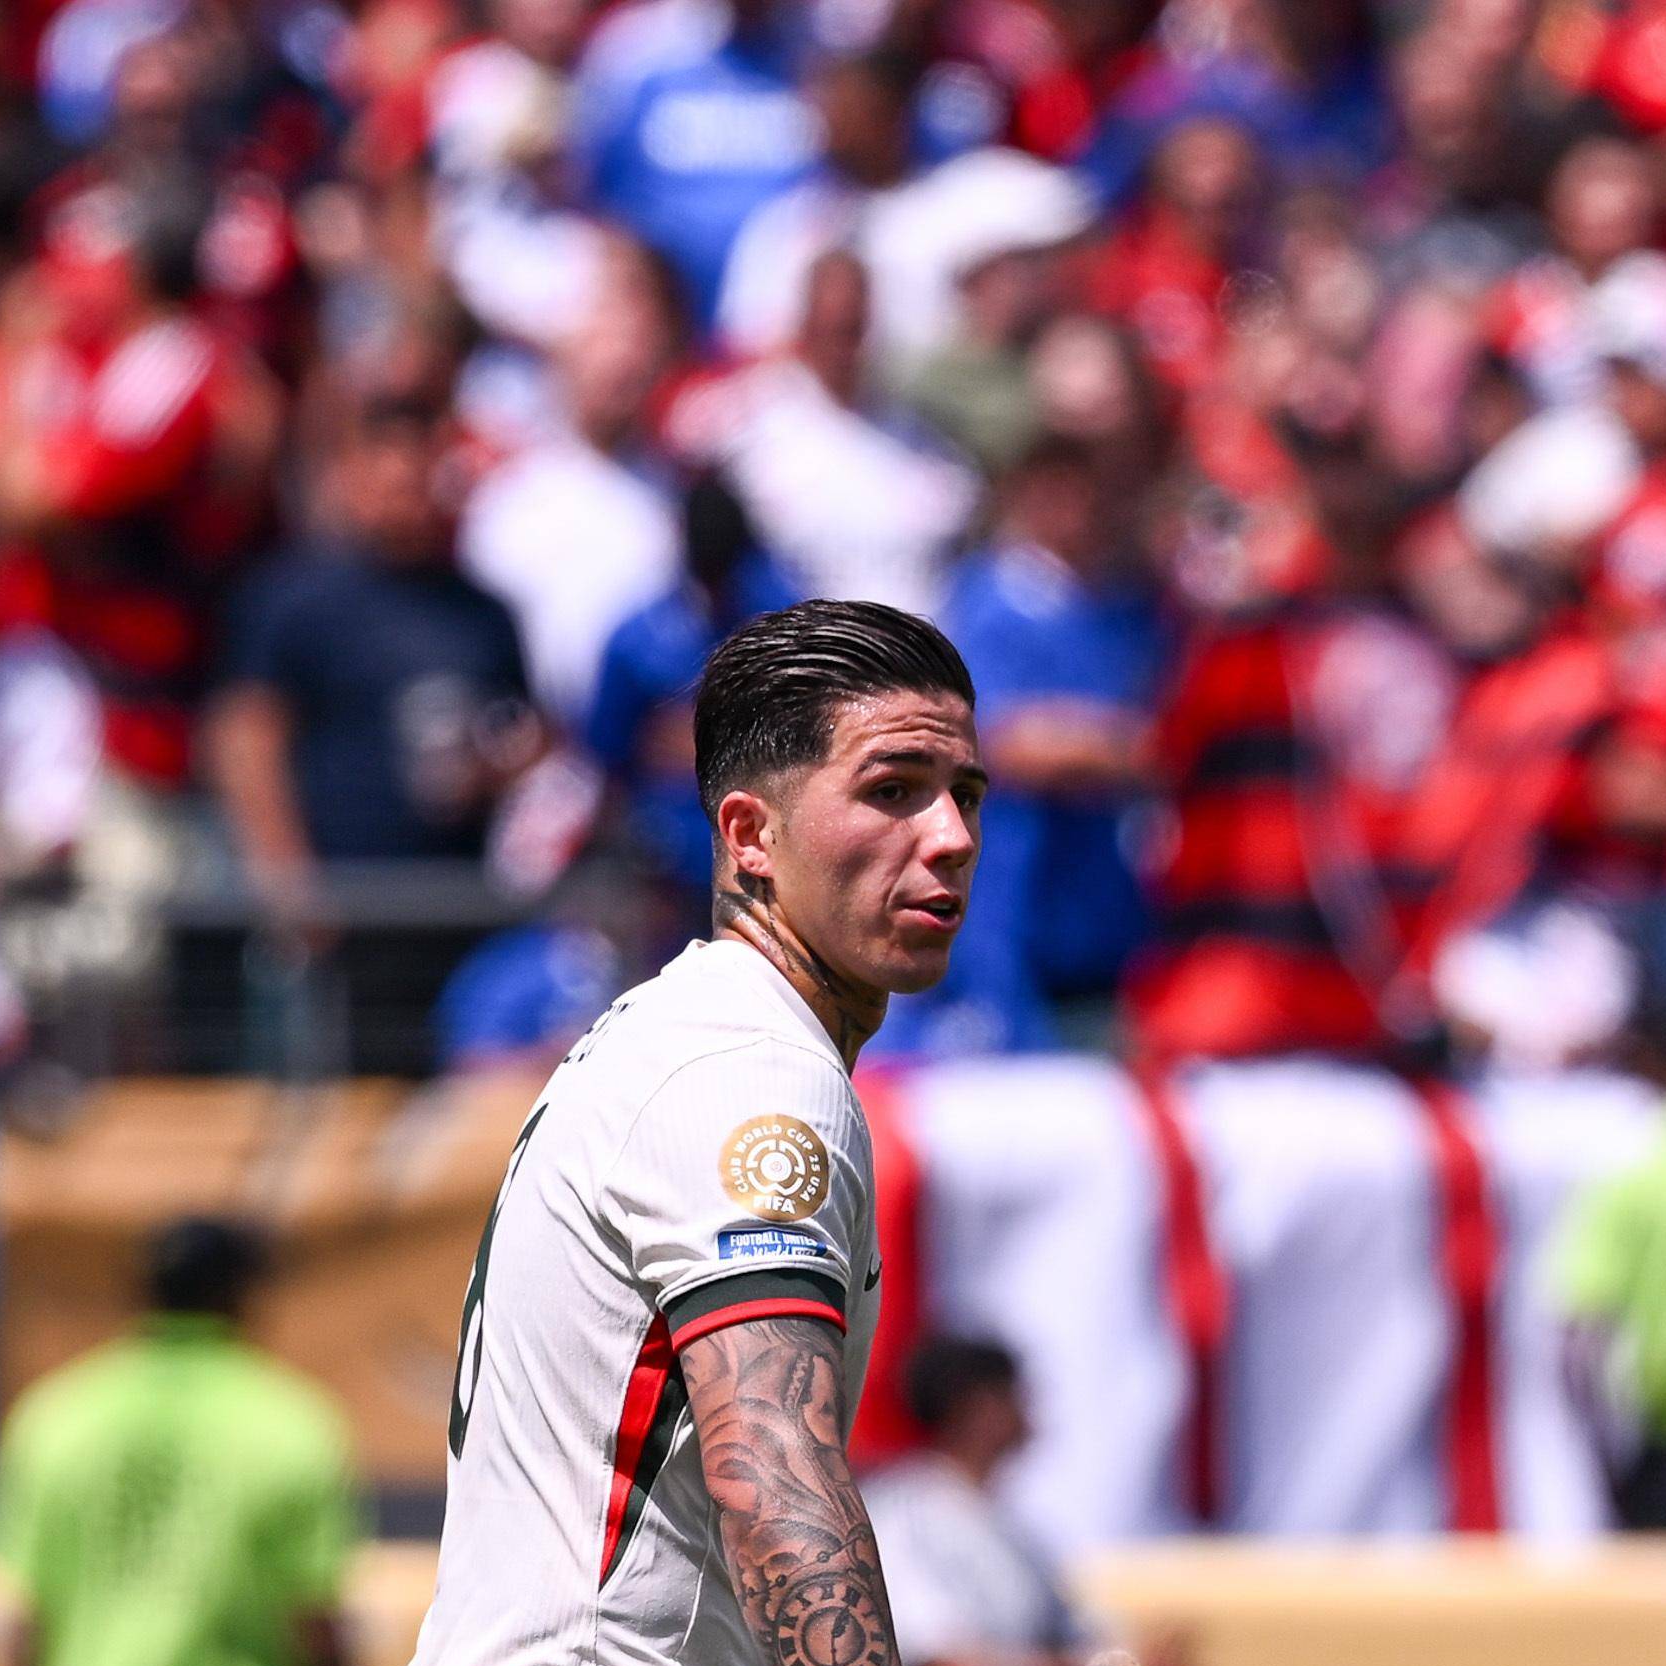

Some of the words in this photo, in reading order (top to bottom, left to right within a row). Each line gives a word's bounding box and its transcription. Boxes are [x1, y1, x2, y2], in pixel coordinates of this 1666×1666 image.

[733, 1124, 782, 1153] WORLD
[786, 1127, 814, 1151] CUP
[729, 1157, 750, 1193] CLUB
[809, 1154, 821, 1172] 25
[799, 1176, 821, 1202] USA
[753, 1195, 796, 1214] FIFA
[730, 1231, 781, 1247] FOOTBALL
